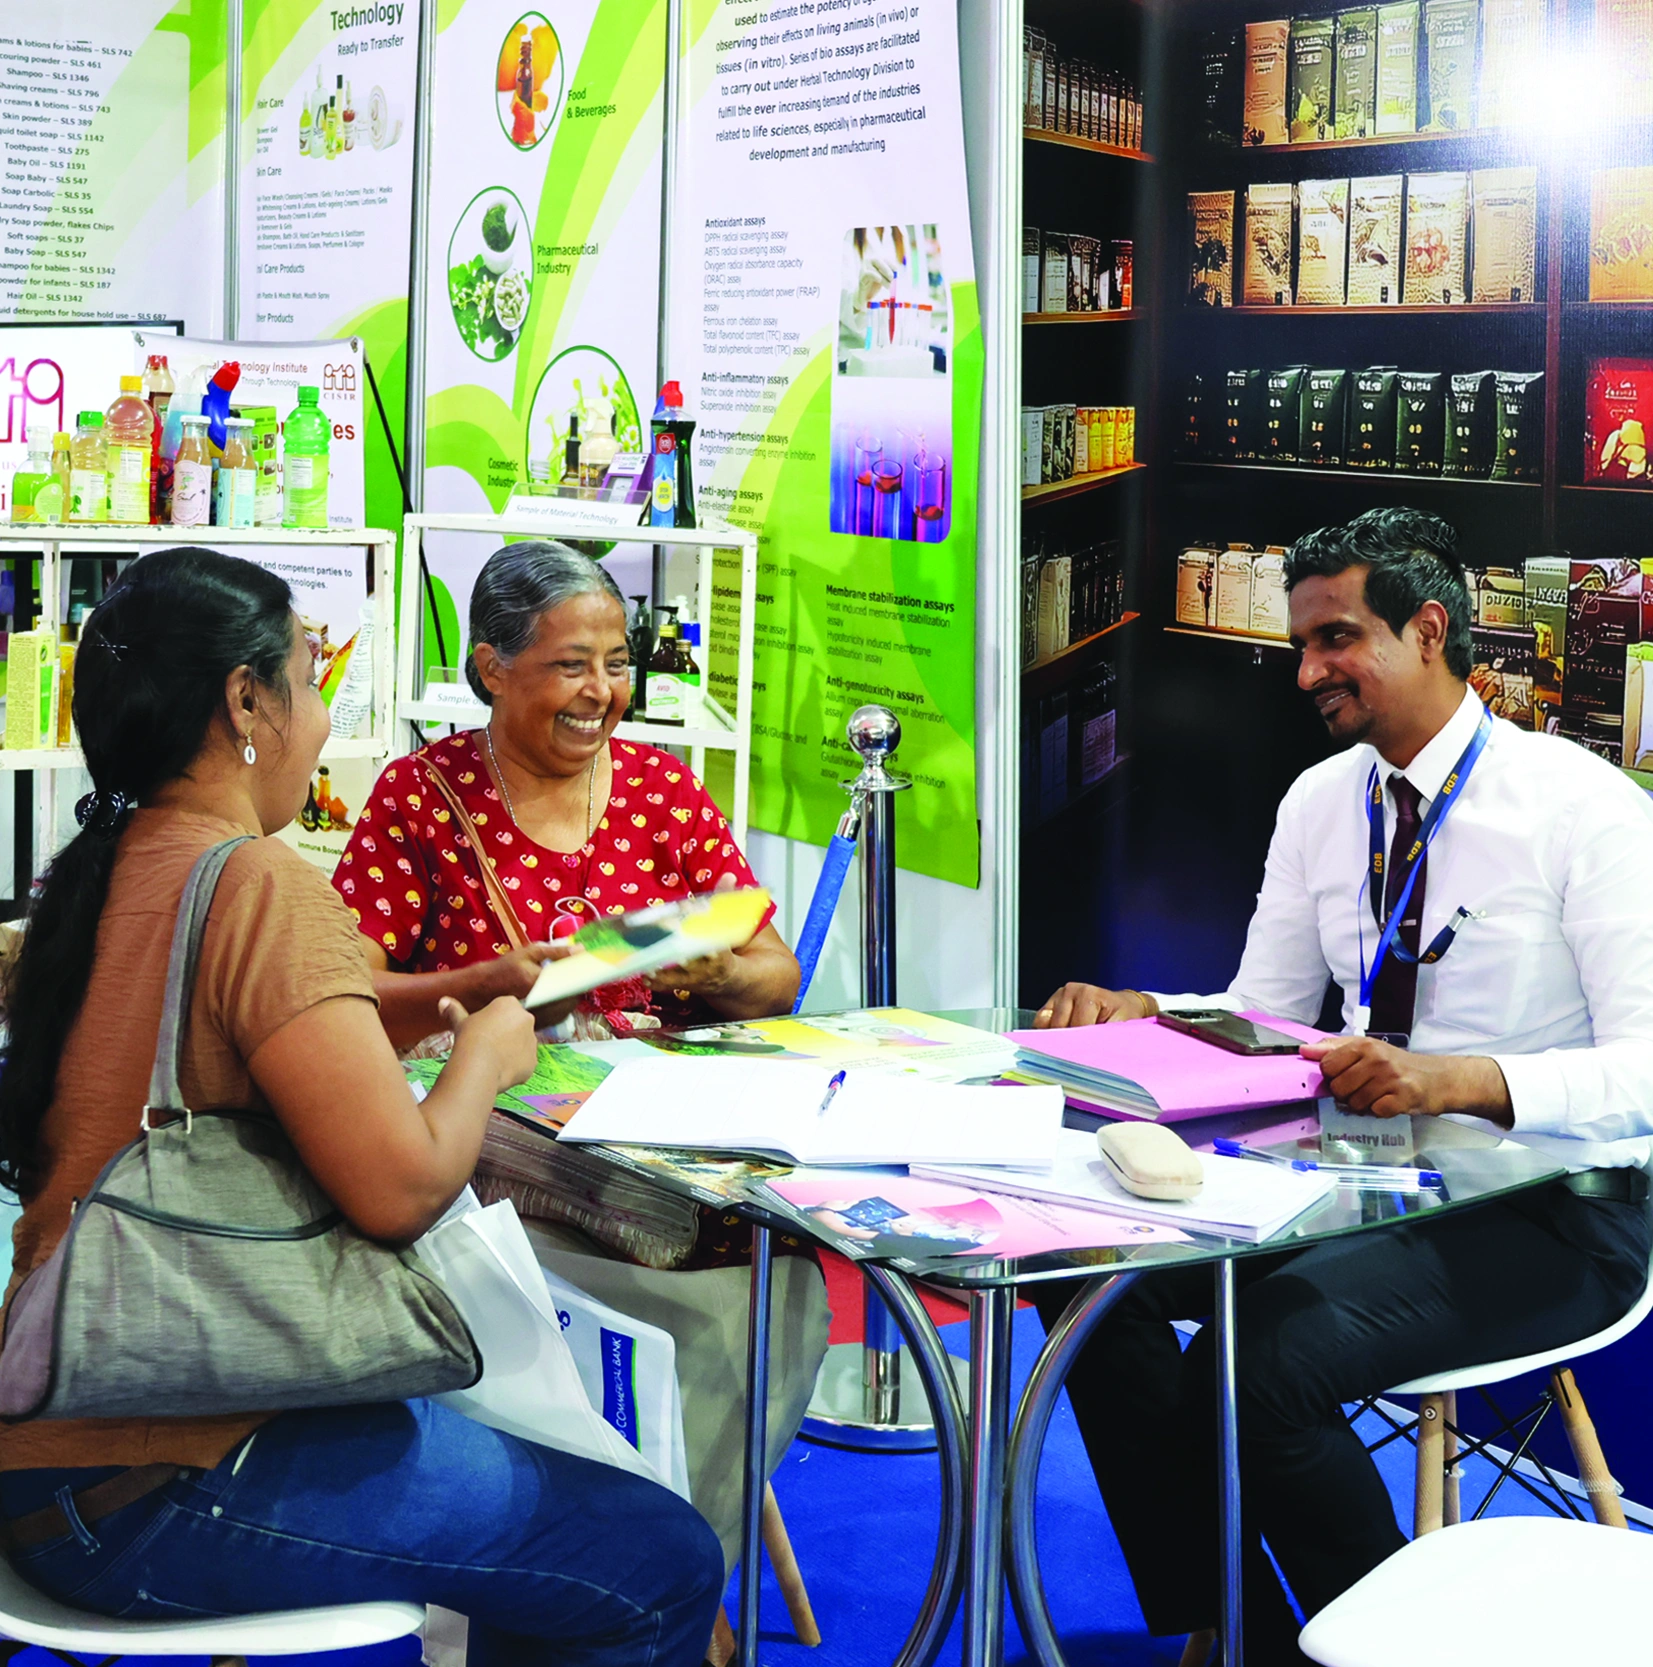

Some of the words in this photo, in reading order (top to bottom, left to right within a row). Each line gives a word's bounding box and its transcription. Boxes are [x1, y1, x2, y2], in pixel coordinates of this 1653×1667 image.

[330, 2, 404, 31] Technology
[735, 13, 757, 26] used
[770, 7, 798, 22] estimate
[800, 4, 815, 14] the
[716, 36, 757, 51] observing
[760, 33, 780, 46] their
[781, 28, 803, 42] effects
[816, 23, 841, 37] living
[843, 15, 874, 32] animals
[888, 7, 908, 23] vivo)
[25, 40, 50, 49] lotions
[53, 42, 64, 50] for
[118, 49, 132, 57] 742
[338, 44, 359, 57] Ready
[361, 41, 368, 52] to
[371, 34, 404, 50] Transfer
[716, 60, 742, 74] tissues
[789, 52, 809, 65] Series
[819, 47, 833, 59] bio
[835, 43, 864, 57] assays
[866, 39, 879, 51] are
[880, 30, 920, 49] facilitated
[31, 56, 60, 67] powder
[7, 68, 43, 79] Shampoo
[70, 74, 89, 82] 1346
[730, 82, 751, 96] carry
[754, 80, 771, 92] out
[773, 77, 798, 91] under
[823, 66, 871, 84] Technology
[873, 59, 903, 75] Division
[30, 86, 58, 94] creams
[568, 88, 586, 101] Food
[4, 99, 32, 107] creams
[43, 101, 69, 110] lotions
[79, 104, 93, 112] SLS
[270, 98, 284, 108] Care
[738, 105, 752, 116] the
[754, 104, 776, 114] ever
[779, 95, 821, 113] increasing
[863, 89, 877, 101] the
[879, 82, 920, 100] industries
[575, 103, 616, 118] Beverages
[2, 112, 19, 120] Skin
[22, 115, 51, 124] powder
[716, 128, 740, 142] related
[752, 125, 768, 137] life
[770, 123, 811, 136] sciences,
[814, 116, 849, 132] especially
[859, 106, 926, 129] pharmaceutical
[17, 128, 37, 137] toilet
[39, 131, 58, 139] soap
[84, 134, 104, 142] 1142
[5, 142, 49, 153] Toothpaste
[749, 143, 809, 162] development
[811, 143, 828, 156] and
[831, 138, 886, 158] manufacturing
[7, 158, 26, 166] Baby
[29, 158, 40, 166] Oil
[268, 167, 282, 176] Care
[5, 172, 25, 181] Soap
[27, 174, 46, 183] Baby
[73, 177, 87, 185] 547
[2, 187, 21, 196] Soap
[23, 188, 55, 197] Carbolic
[0, 203, 30, 212] Laundry
[33, 204, 52, 213] Soap
[12, 218, 31, 226] Soap
[68, 220, 90, 229] flakes
[93, 222, 114, 231] Chips
[705, 217, 742, 228] Antioxidant
[744, 217, 766, 226] assays
[7, 232, 23, 240] Soft
[26, 234, 48, 242] soaps
[5, 247, 23, 256] Baby
[26, 248, 45, 257] Soap
[537, 243, 599, 256] Pharmaceutical
[45, 264, 70, 272] babies
[97, 267, 116, 275] 1342
[264, 264, 278, 274] Care
[280, 264, 305, 274] Products
[537, 263, 571, 276] Industry
[43, 278, 70, 287] infants
[7, 292, 23, 300] Hair
[776, 287, 795, 299] power
[796, 287, 820, 299] (FRAP)
[13, 307, 56, 316] detergents
[72, 310, 95, 318] house
[97, 311, 113, 319] hold
[268, 313, 294, 323] Products
[273, 362, 308, 373] Institute
[701, 372, 766, 386] Anti-inflammatory
[767, 375, 789, 386] assays
[700, 429, 766, 442] Anti-hypertension
[767, 434, 788, 445] assays
[488, 458, 518, 472] Cosmetic
[698, 485, 737, 499] Anti-aging
[739, 490, 763, 500] assays
[516, 505, 539, 516] Sample
[542, 508, 550, 518] of
[551, 509, 578, 519] Material
[580, 512, 619, 525] Technology
[278, 563, 315, 573] competent
[317, 567, 342, 576] parties
[826, 585, 867, 600] Membrane
[869, 592, 921, 607] stabilization
[924, 600, 955, 612] assays
[826, 675, 894, 699] Anti-genotoxicity
[896, 690, 924, 704] assays
[437, 693, 471, 705] Sample
[1327, 1133, 1379, 1147] Industry
[1382, 1134, 1405, 1146] Hub
[612, 1337, 622, 1367] BANK
[614, 1368, 627, 1428] COMMERCIAL
